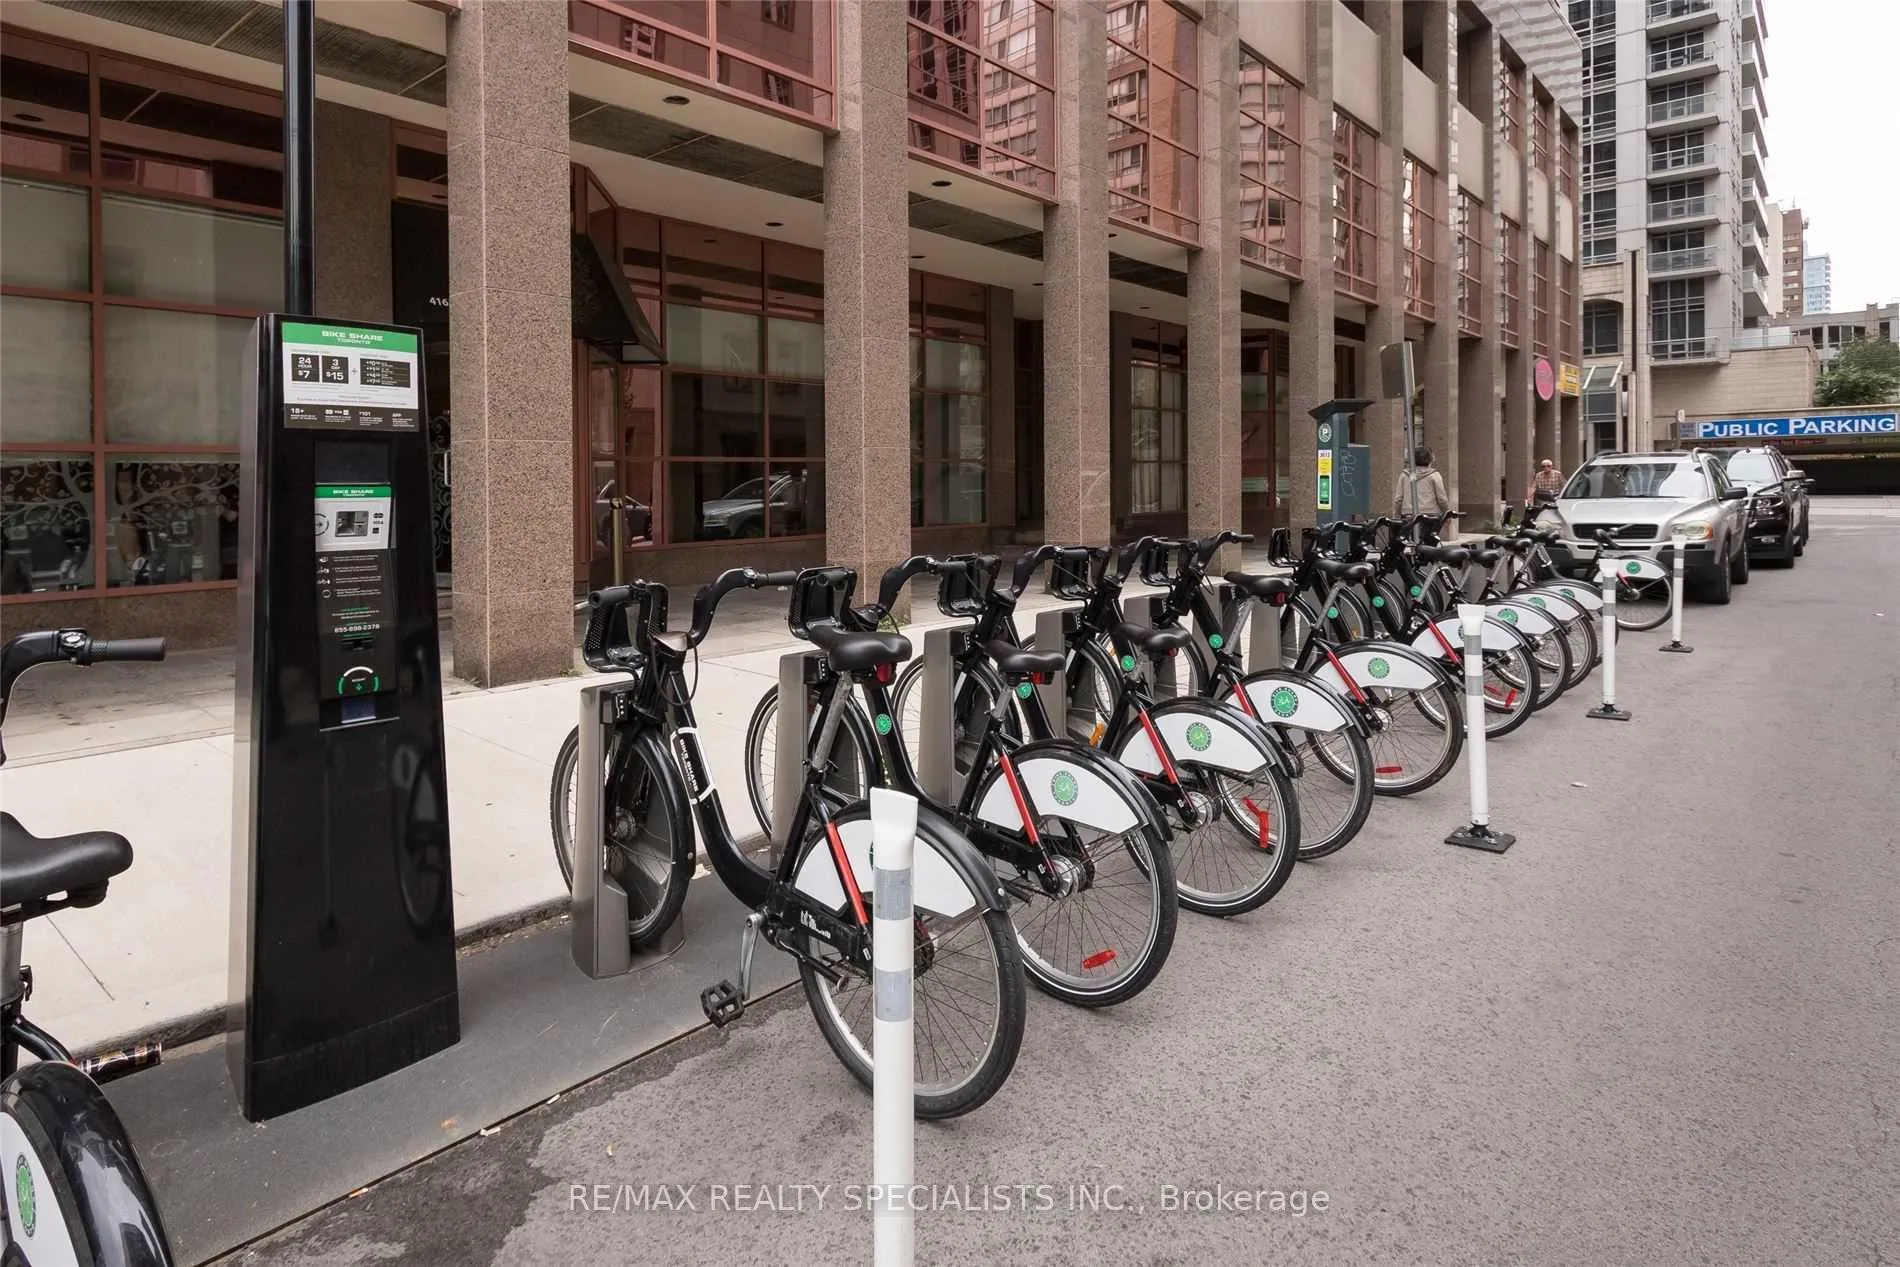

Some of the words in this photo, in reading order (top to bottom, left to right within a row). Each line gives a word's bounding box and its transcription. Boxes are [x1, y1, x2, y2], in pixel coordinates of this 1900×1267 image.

[429, 297, 449, 307] 416
[321, 330, 346, 338] BIKE
[349, 333, 384, 342] SHARE
[298, 356, 312, 365] 24
[298, 370, 310, 379] $7
[326, 371, 344, 381] $15
[1699, 422, 1778, 438] PUBLIC
[1788, 417, 1895, 435] PARKING
